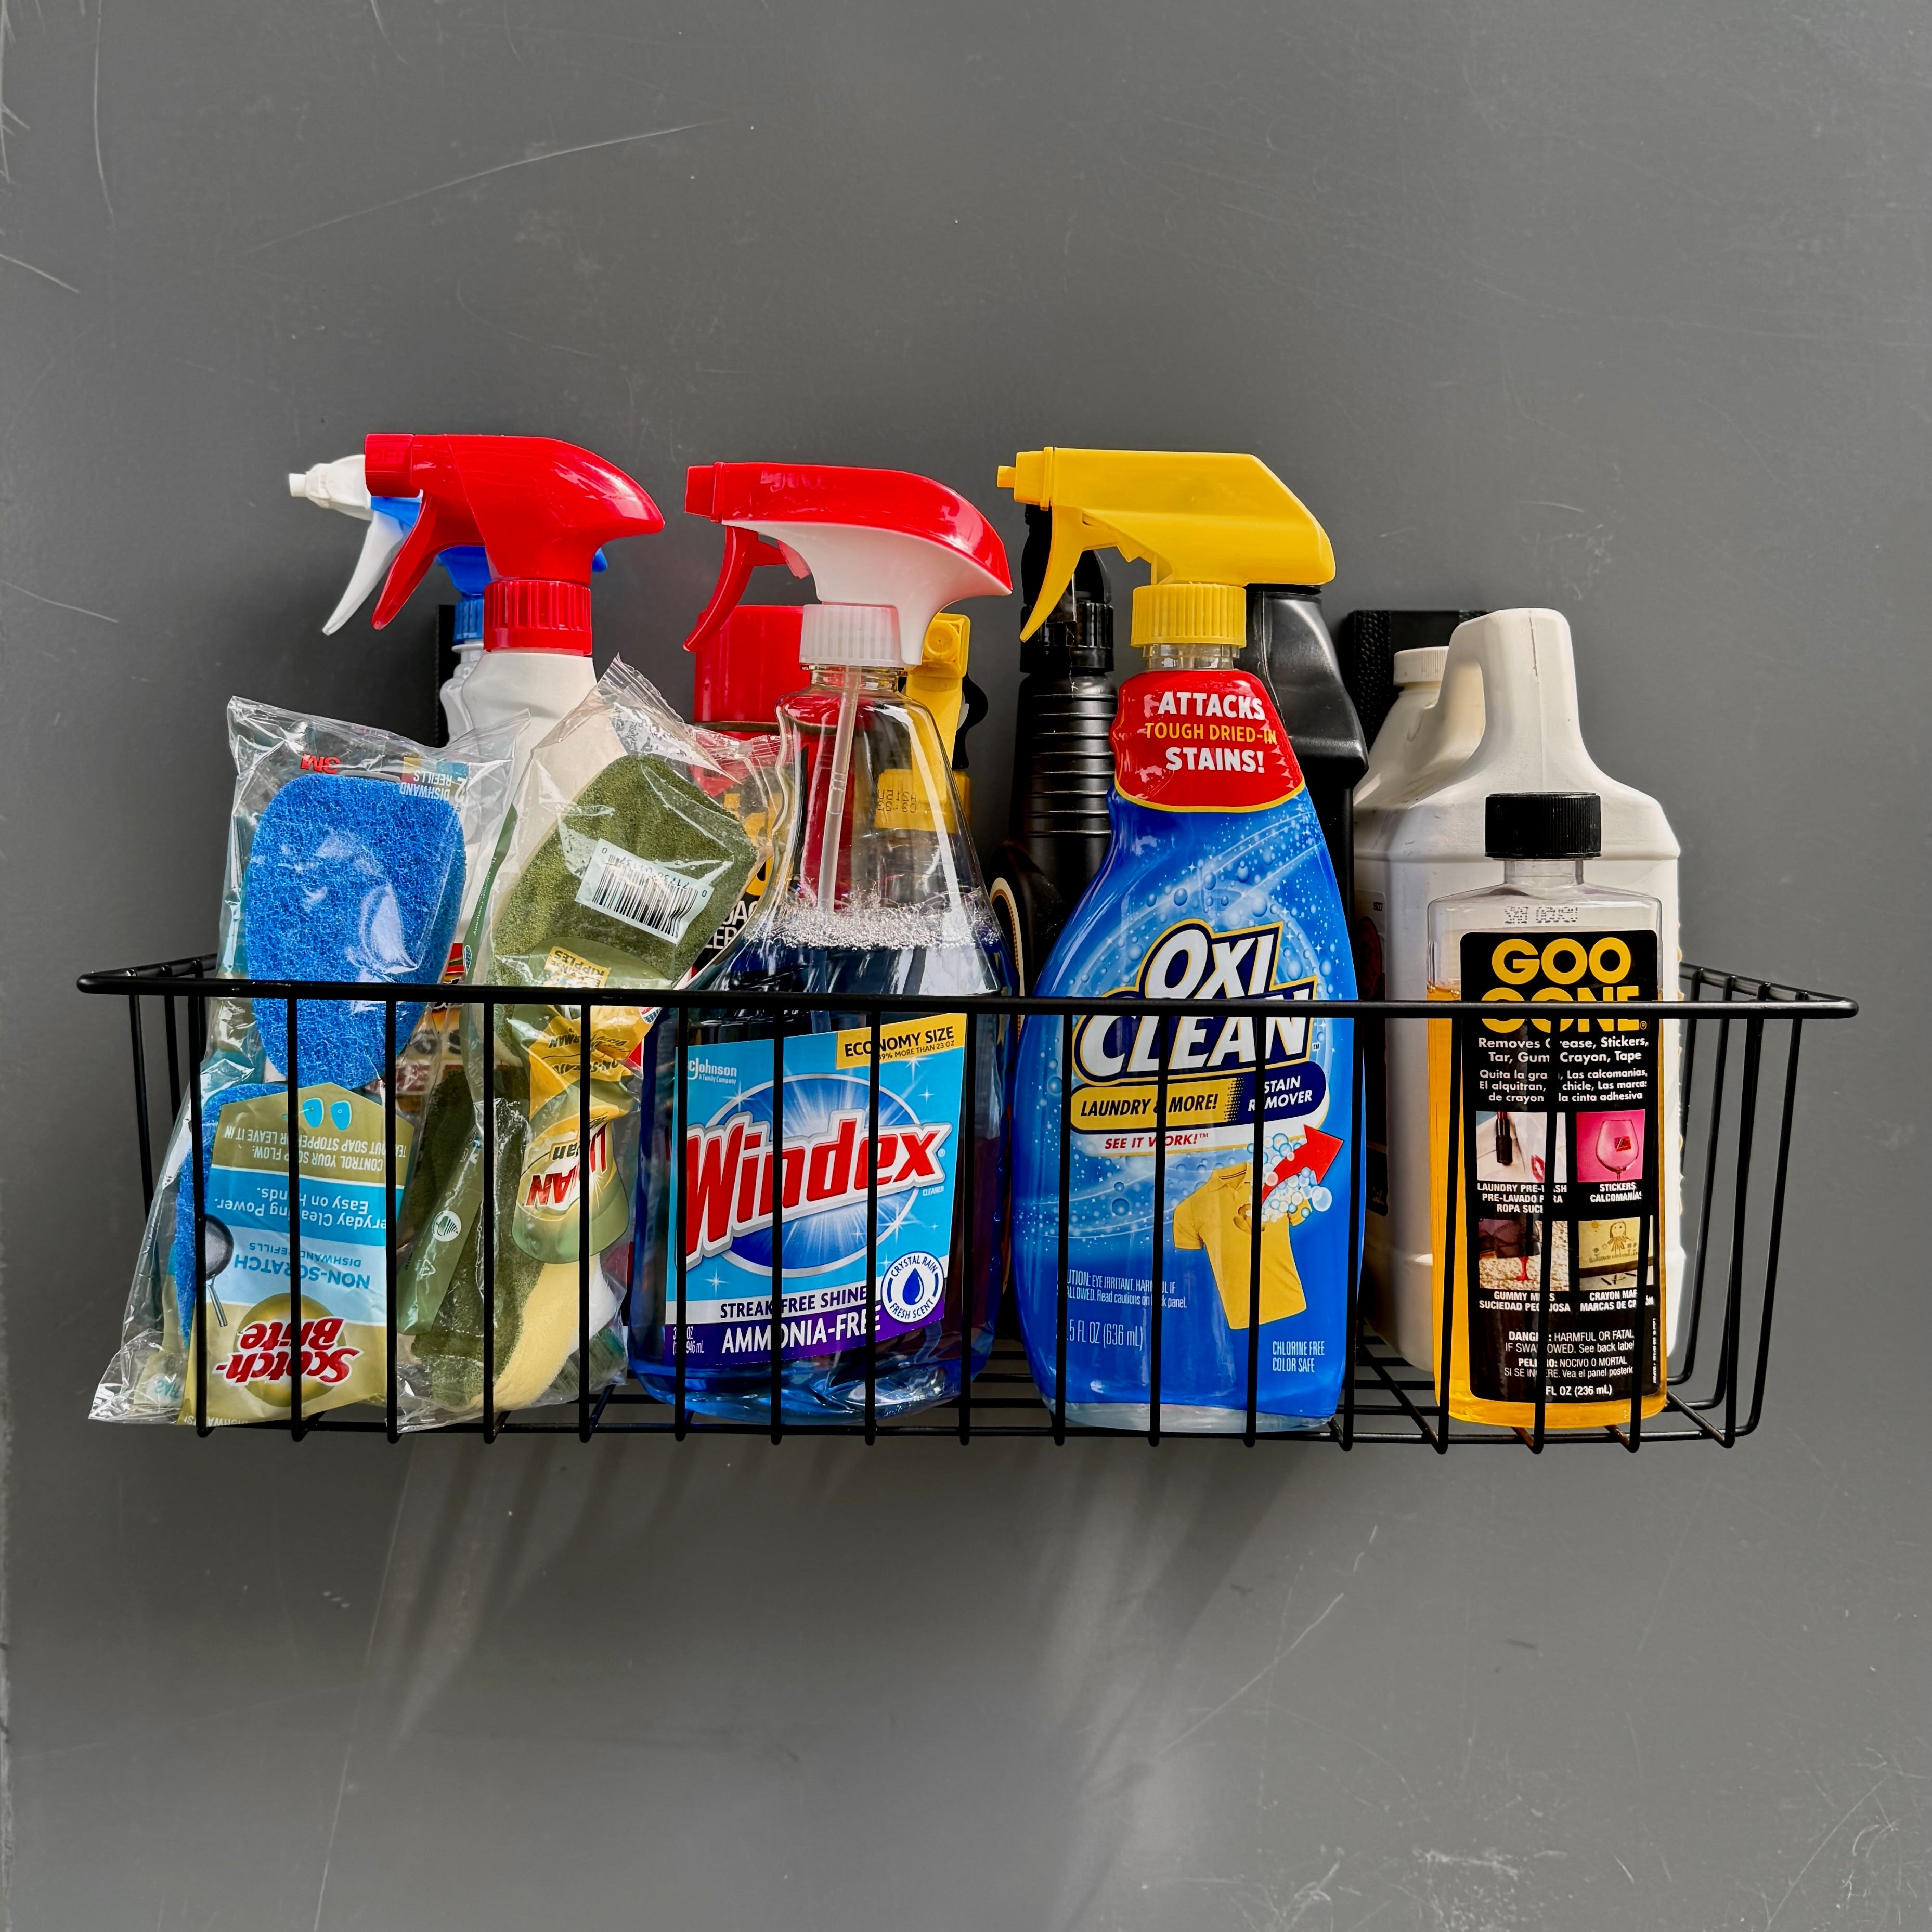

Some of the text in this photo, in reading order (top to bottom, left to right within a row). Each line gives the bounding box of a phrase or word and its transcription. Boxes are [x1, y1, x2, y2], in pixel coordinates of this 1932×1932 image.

[1158, 691, 1266, 720] ATTACKS
[1145, 722, 1277, 745] TOUGH DRIED-IN
[300, 753, 341, 774] 3M
[1165, 747, 1264, 773] STAINS!
[413, 770, 452, 785] REFILLS
[400, 782, 449, 801] DISHWAND
[455, 777, 468, 803] 2
[1145, 929, 1274, 999] OXI
[1492, 937, 1631, 985] GOO
[1080, 988, 1309, 1077] CLEAN
[845, 1026, 954, 1057] ECONOMY SIZE
[1479, 1035, 1649, 1049] Removes ease, Stickers,
[895, 1047, 914, 1057] MORE
[916, 1044, 935, 1054] THAN
[1488, 1052, 1513, 1064] Tar,
[1560, 1052, 1611, 1065] Crayon,
[1614, 1051, 1642, 1064] Tape
[702, 1074, 716, 1083] Family
[716, 1076, 736, 1085] Company
[1480, 1069, 1510, 1080] Quita
[1514, 1069, 1524, 1079] la
[1567, 1070, 1584, 1079] Las
[1264, 1076, 1301, 1094] STAIN
[1479, 1081, 1487, 1090] El
[1562, 1081, 1594, 1091] chicle,
[1598, 1081, 1614, 1090] Las
[1248, 1090, 1312, 1112] RMOVER
[1489, 1091, 1642, 1104] de crayon la cinta adhesiva
[1081, 1098, 1151, 1117] LAUNDRY
[1169, 1094, 1218, 1113] MORE!
[225, 1125, 235, 1138] IN
[236, 1127, 244, 1141] IT
[248, 1129, 277, 1144] LEAVE
[341, 1139, 368, 1153] SOAP
[1105, 1138, 1126, 1149] SEE
[1132, 1137, 1144, 1148] IT
[252, 1145, 383, 1171] CONTROL YOUR SOP FLOW:
[686, 1118, 940, 1256] Windex
[923, 1186, 944, 1196] CLEANER
[1477, 1183, 1567, 1193] LAUNDRY PRE-SH
[1600, 1182, 1637, 1192] STICKERS
[257, 1187, 369, 1215] Easy on Hnds.
[1482, 1193, 1563, 1203] PRE-LAVADO PRA
[215, 1198, 386, 1230] eryday Cleang Power.
[1497, 1204, 1543, 1213] ROPA SUCI
[249, 1242, 361, 1267] DISHWAND EFILLS
[891, 1255, 938, 1277] CRYSTAL RAIN
[1063, 1269, 1175, 1294] UTION: EYE IRRITANT. HARL IF
[821, 1285, 867, 1308] SHINE
[1063, 1286, 1096, 1301] LLOWED.
[1097, 1290, 1112, 1302] Read
[1114, 1292, 1140, 1305] cautions
[1142, 1295, 1150, 1306] on
[1168, 1296, 1187, 1308] panel.
[1494, 1291, 1527, 1300] GUMMY
[1589, 1291, 1620, 1301] CRAYON
[890, 1298, 933, 1319] FRESH SCENT
[1479, 1301, 1571, 1312] SUCIEDAD PEJOSA
[1580, 1301, 1614, 1311] MARCAS
[1616, 1300, 1626, 1309] DE
[686, 1326, 693, 1340] OZ
[1078, 1320, 1086, 1343] FL
[1090, 1321, 1100, 1344] OZ
[1103, 1322, 1123, 1348] (636
[1127, 1326, 1143, 1351] mL)
[1509, 1331, 1551, 1342] DANG:
[1554, 1331, 1596, 1342] HARMFUL
[1599, 1331, 1610, 1341] OR
[686, 1340, 695, 1354] 946
[1273, 1341, 1325, 1355] CHLORINE FREE
[1506, 1343, 1513, 1352] IF
[1516, 1343, 1576, 1353] SWAOWED.
[1579, 1343, 1594, 1353] See
[1597, 1342, 1616, 1352] back
[217, 1348, 360, 1383] Scotch-
[1273, 1357, 1315, 1372] COLOR SAFE
[1519, 1356, 1627, 1368] PELIO: NOCIVO O MORTAL
[1505, 1365, 1633, 1378] SI SE INRE. Vea el panel posteri
[1546, 1384, 1612, 1397] FL OZ (236 mL)
